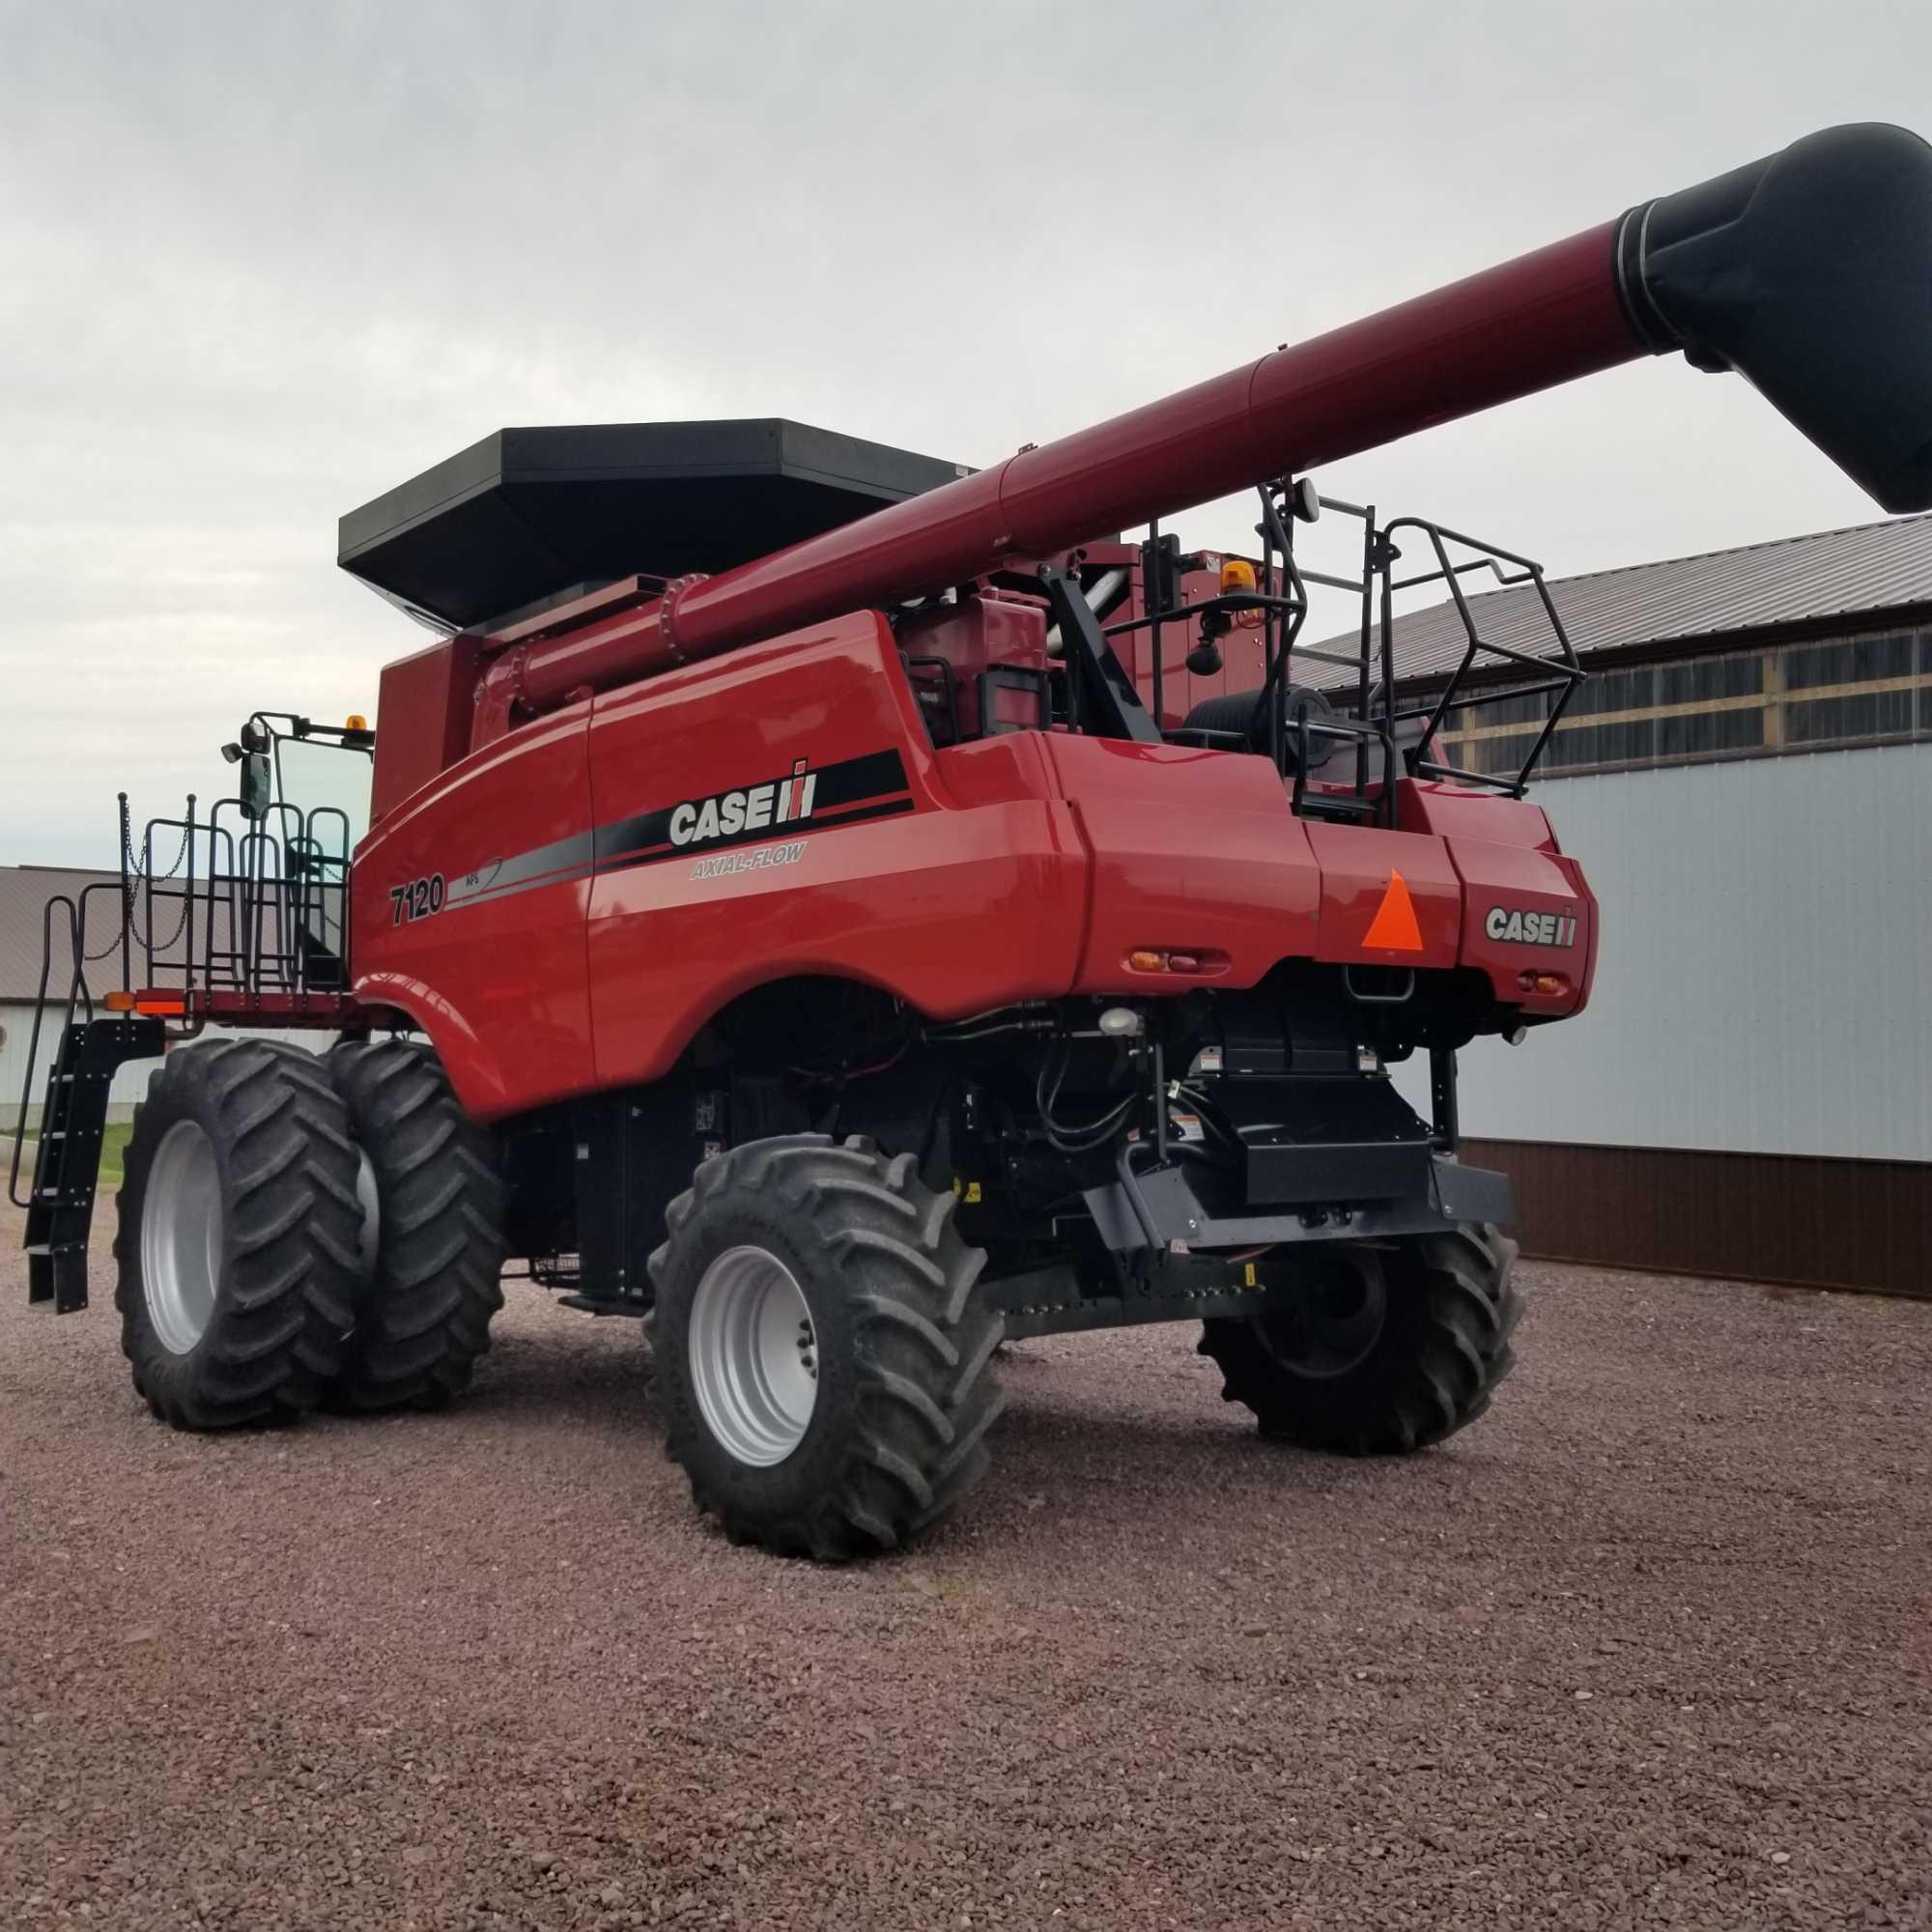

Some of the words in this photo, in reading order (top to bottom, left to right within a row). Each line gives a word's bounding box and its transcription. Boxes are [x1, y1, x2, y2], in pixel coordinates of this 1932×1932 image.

[669, 784, 775, 846] CASE
[689, 841, 808, 881] AXIAL-FLOW
[390, 872, 444, 927] 7120
[1485, 906, 1556, 944] CASE
